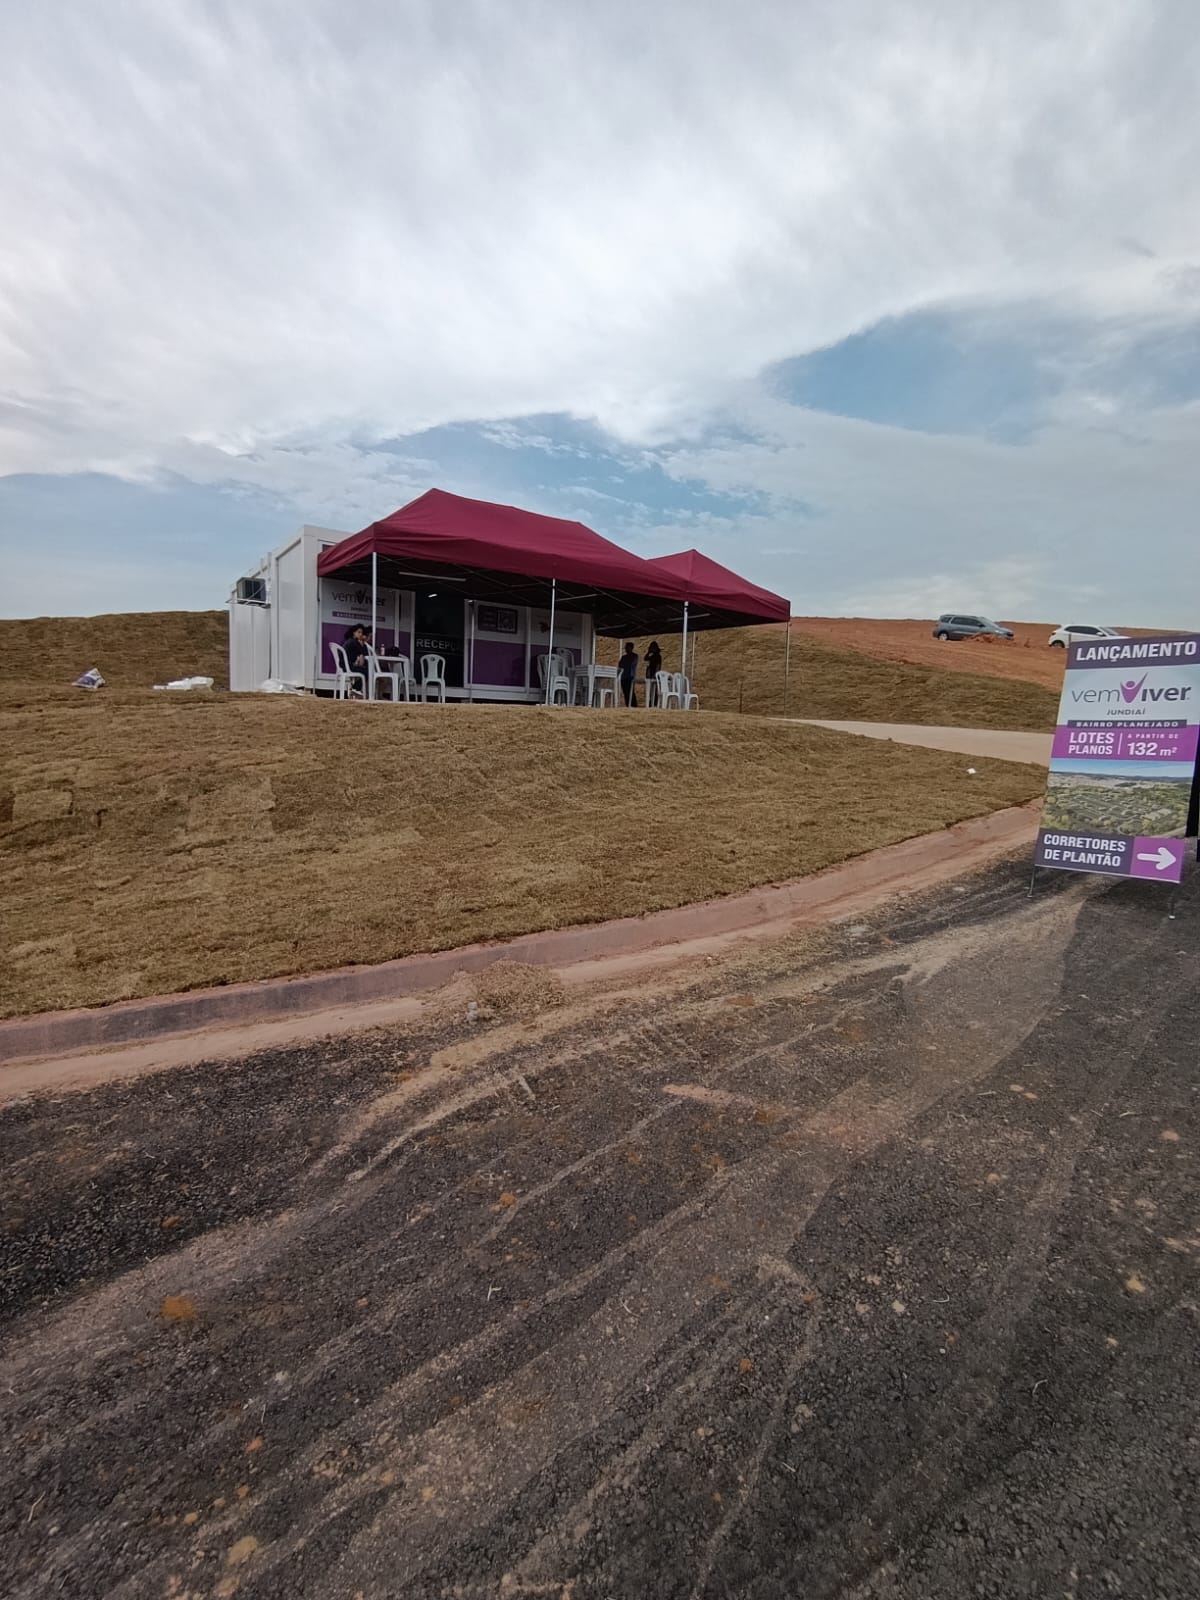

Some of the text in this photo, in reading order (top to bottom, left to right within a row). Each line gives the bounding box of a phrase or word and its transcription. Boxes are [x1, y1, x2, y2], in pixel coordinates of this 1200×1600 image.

[331, 590, 386, 606] vemVier
[1076, 641, 1197, 662] LANÇAMENTO
[1069, 732, 1115, 744] LOTES
[1068, 744, 1113, 755] PLANOS
[1127, 742, 1158, 756] 132
[1043, 834, 1126, 852] CORRETORES
[1044, 848, 1121, 867] DE PLANTÃO
